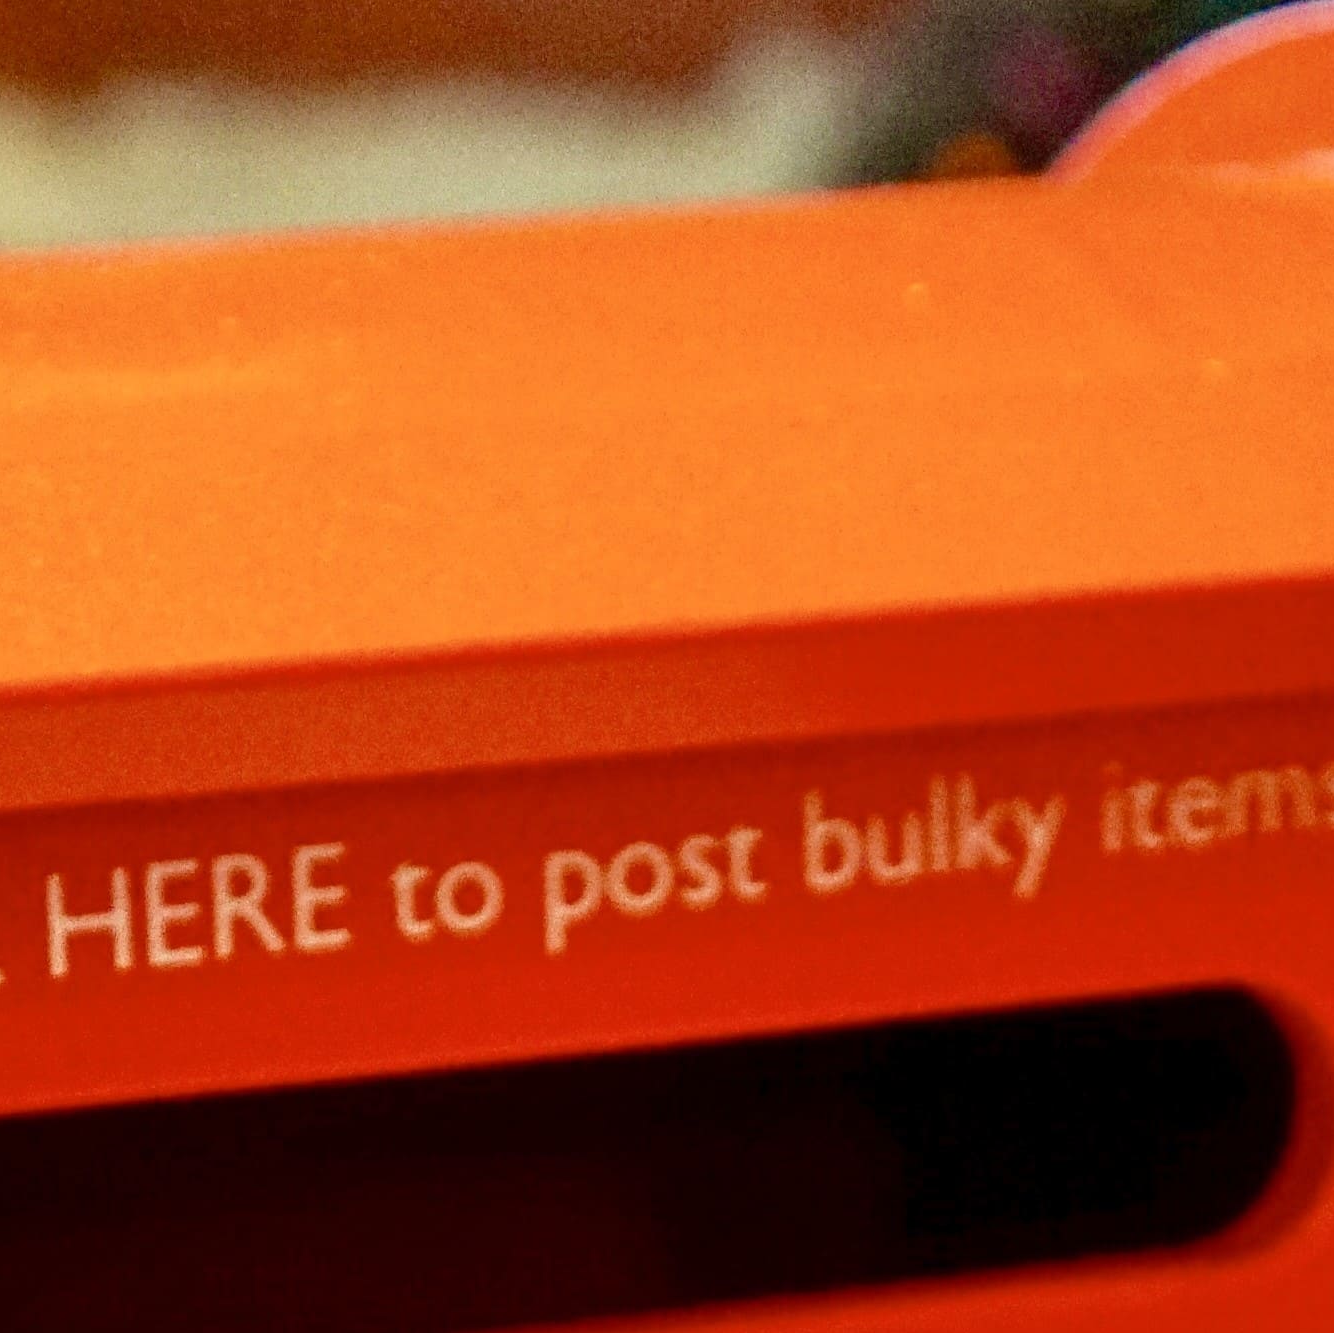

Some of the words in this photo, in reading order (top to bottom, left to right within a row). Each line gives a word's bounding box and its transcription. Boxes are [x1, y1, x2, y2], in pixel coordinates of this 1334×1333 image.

[45, 842, 353, 980] HERE
[389, 860, 505, 942] to
[541, 826, 767, 955] post
[803, 784, 1067, 897] bulky
